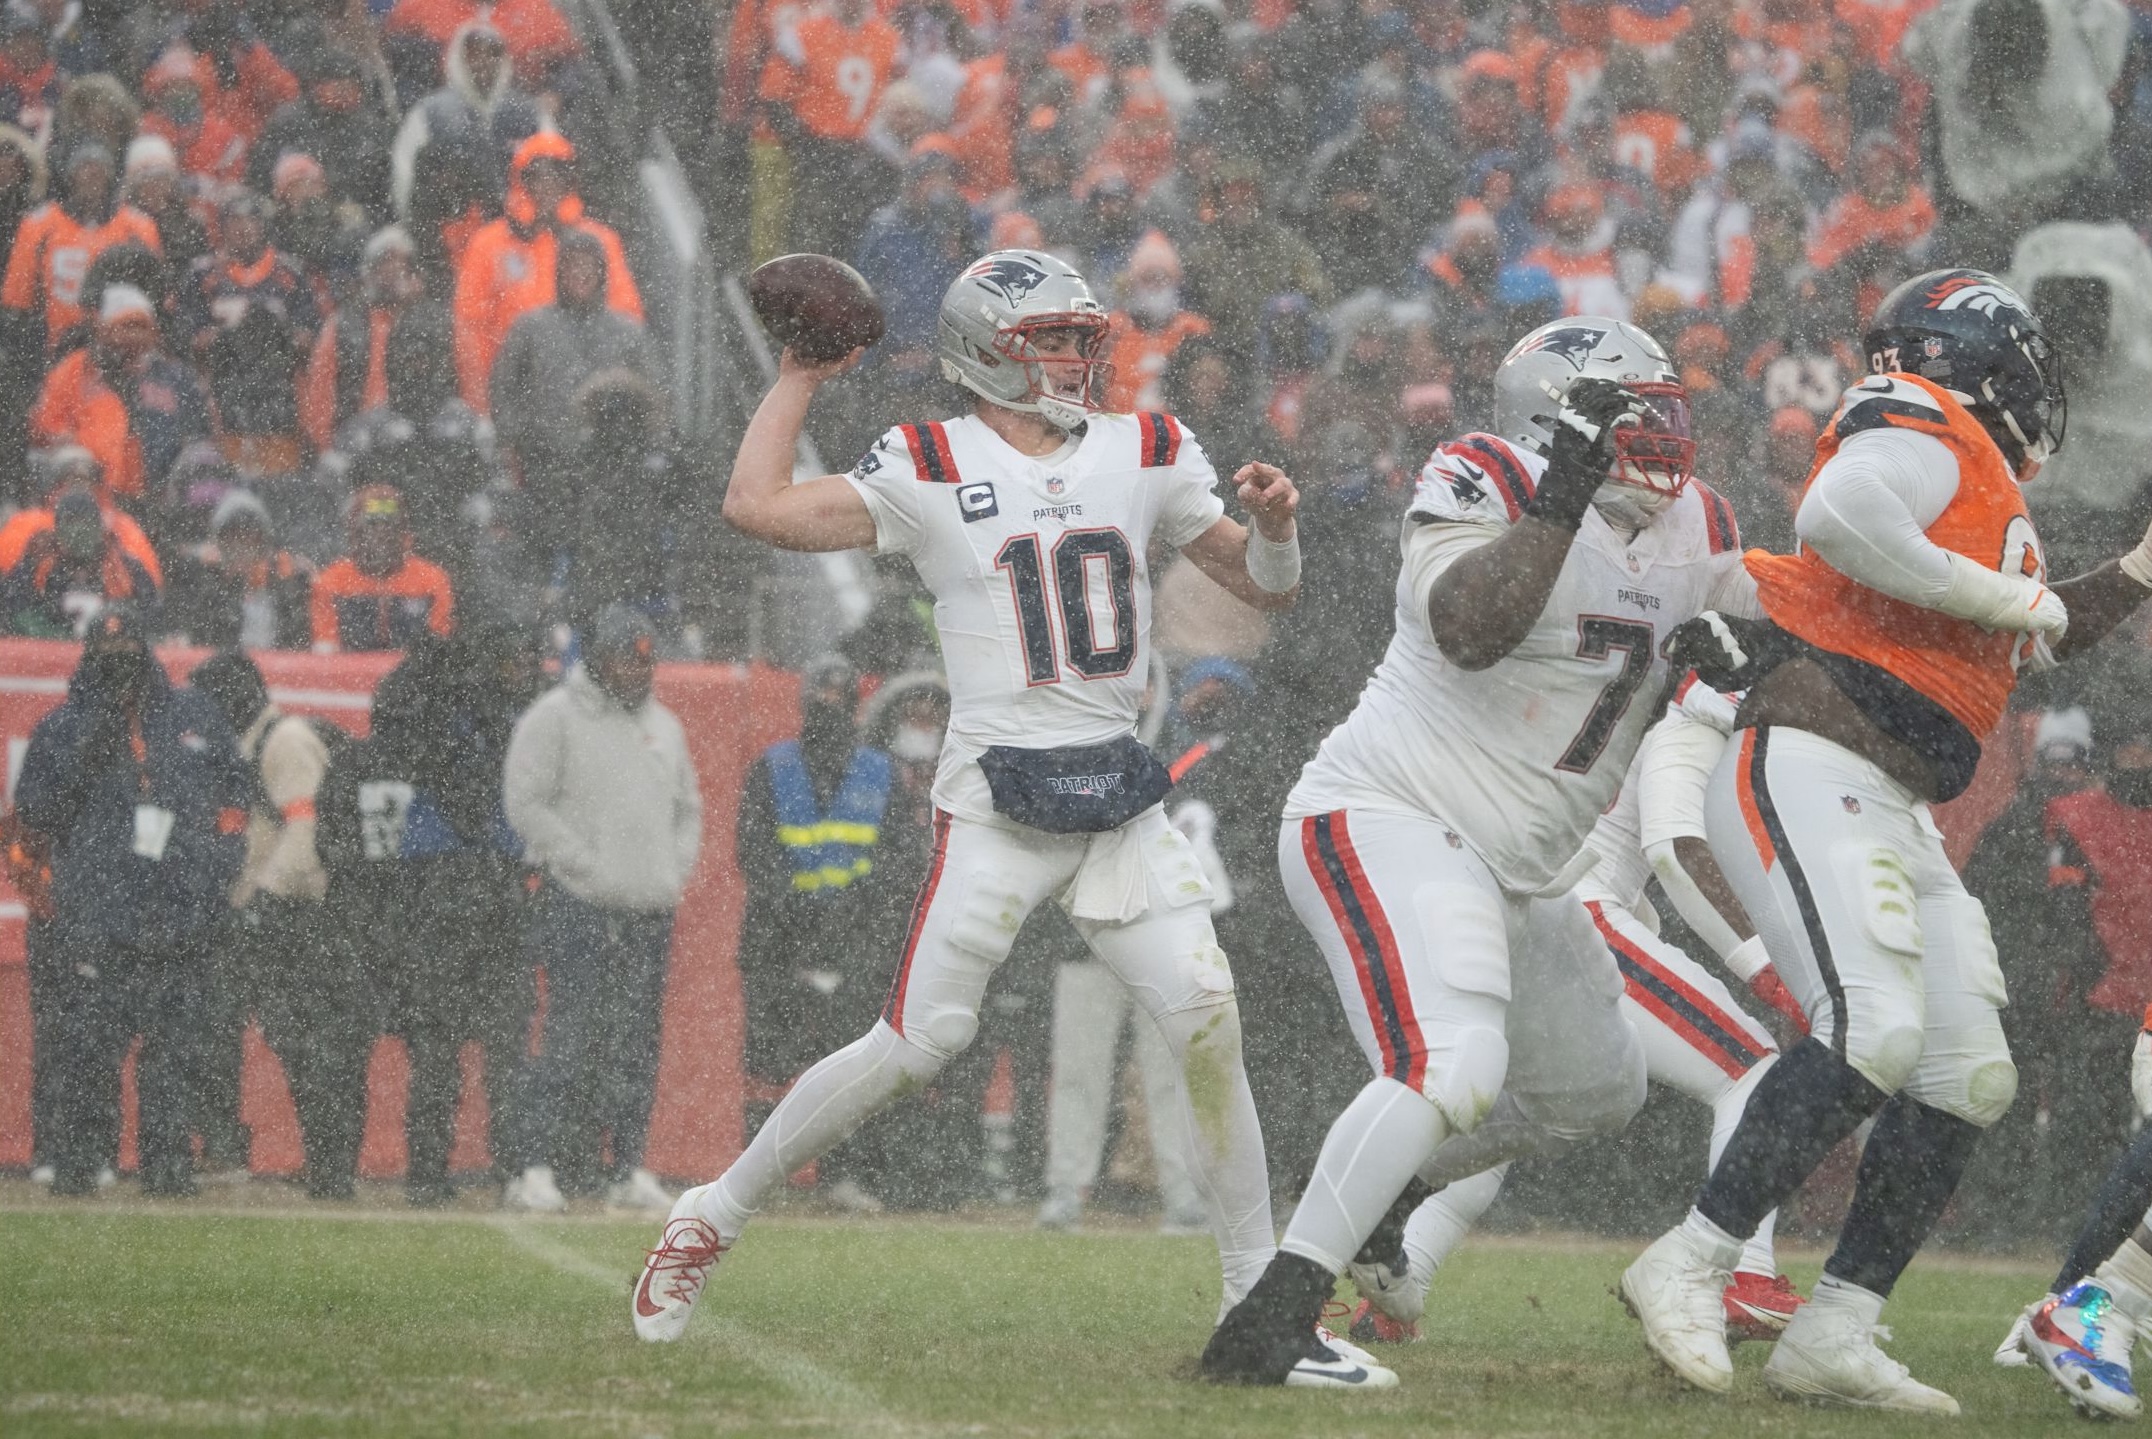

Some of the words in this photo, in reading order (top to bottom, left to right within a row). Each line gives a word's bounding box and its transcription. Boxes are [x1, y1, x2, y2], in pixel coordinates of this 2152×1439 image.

[838, 56, 872, 120] 9
[53, 247, 88, 303] 5
[1872, 347, 1902, 375] 93
[960, 485, 994, 513] C
[1033, 504, 1082, 521] PATRIOTS
[994, 526, 1138, 687] 10
[1618, 589, 1660, 610] PATRIOTS
[1554, 614, 1682, 774] 7
[1046, 773, 1125, 796] PATRIOT
